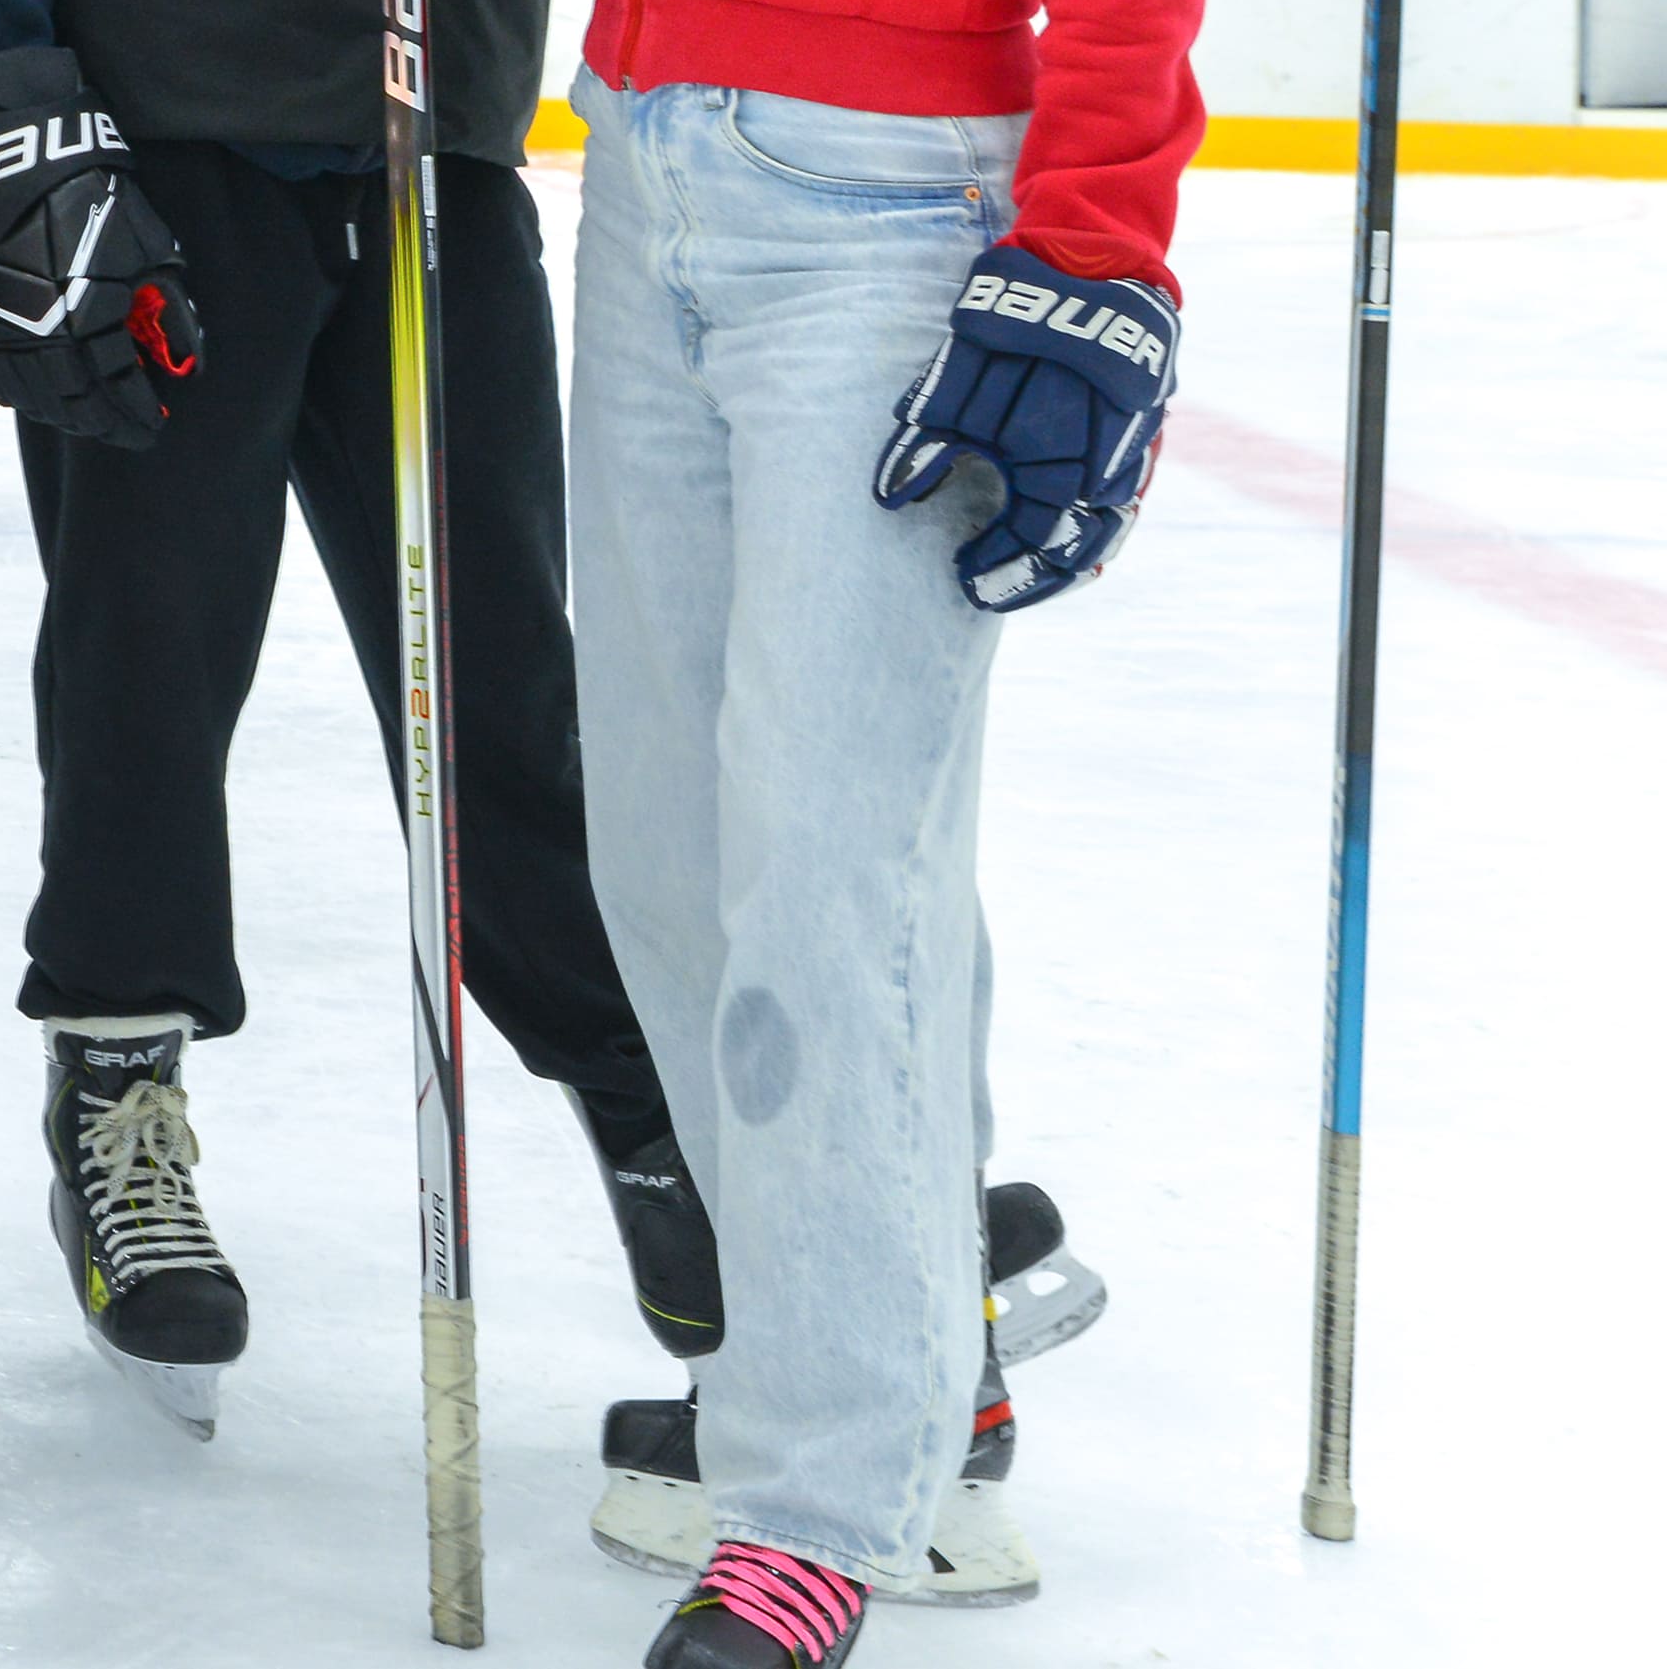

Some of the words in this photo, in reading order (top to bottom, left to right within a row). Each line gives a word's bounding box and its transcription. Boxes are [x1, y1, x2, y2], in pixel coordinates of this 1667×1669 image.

[956, 274, 1167, 378] BAUER
[84, 1044, 167, 1068] GRAF
[614, 1168, 677, 1190] GRAF
